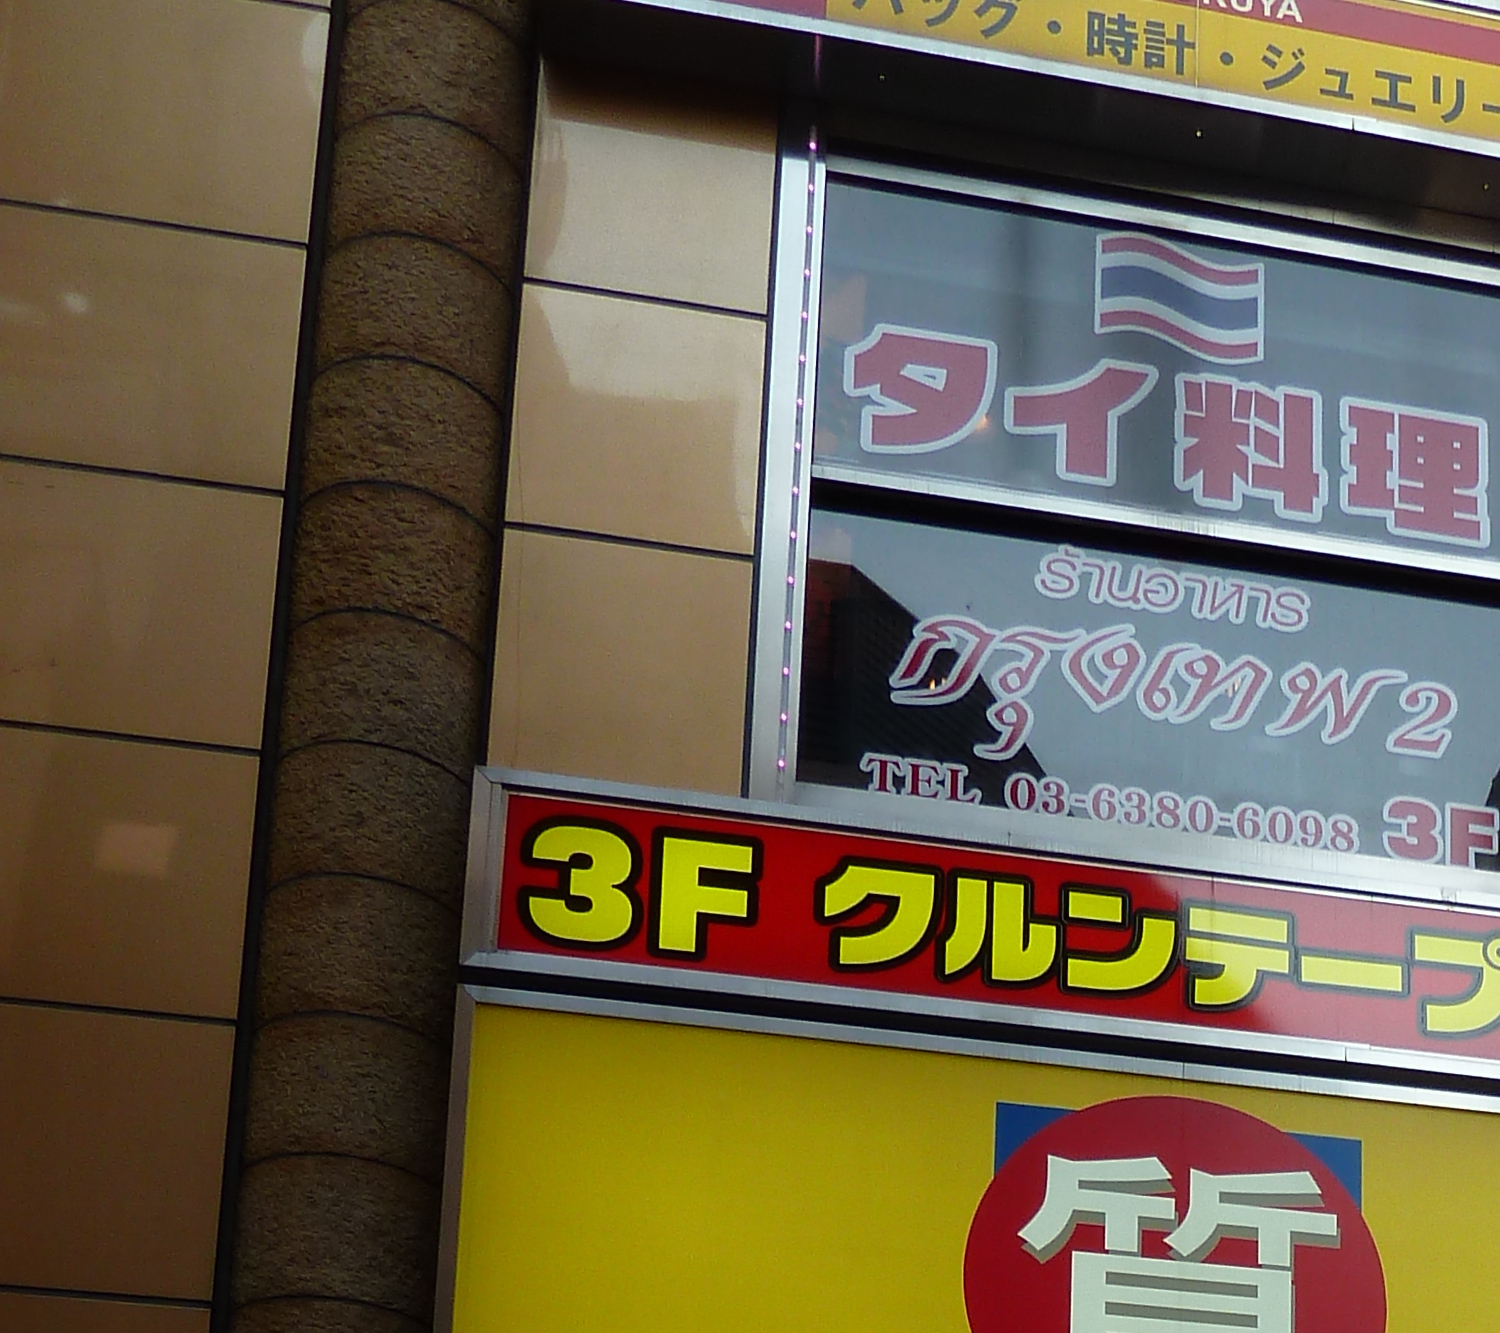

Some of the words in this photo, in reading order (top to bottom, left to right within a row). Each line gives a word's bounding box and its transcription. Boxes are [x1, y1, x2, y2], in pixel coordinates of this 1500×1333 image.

[844, 324, 1491, 548] タイ料理
[1036, 546, 1311, 632] ร้านอาหาร
[859, 753, 981, 804] TEL
[1005, 772, 1358, 853] 03-6380-6098
[1383, 797, 1500, 867] 3F
[520, 823, 757, 959] 3F
